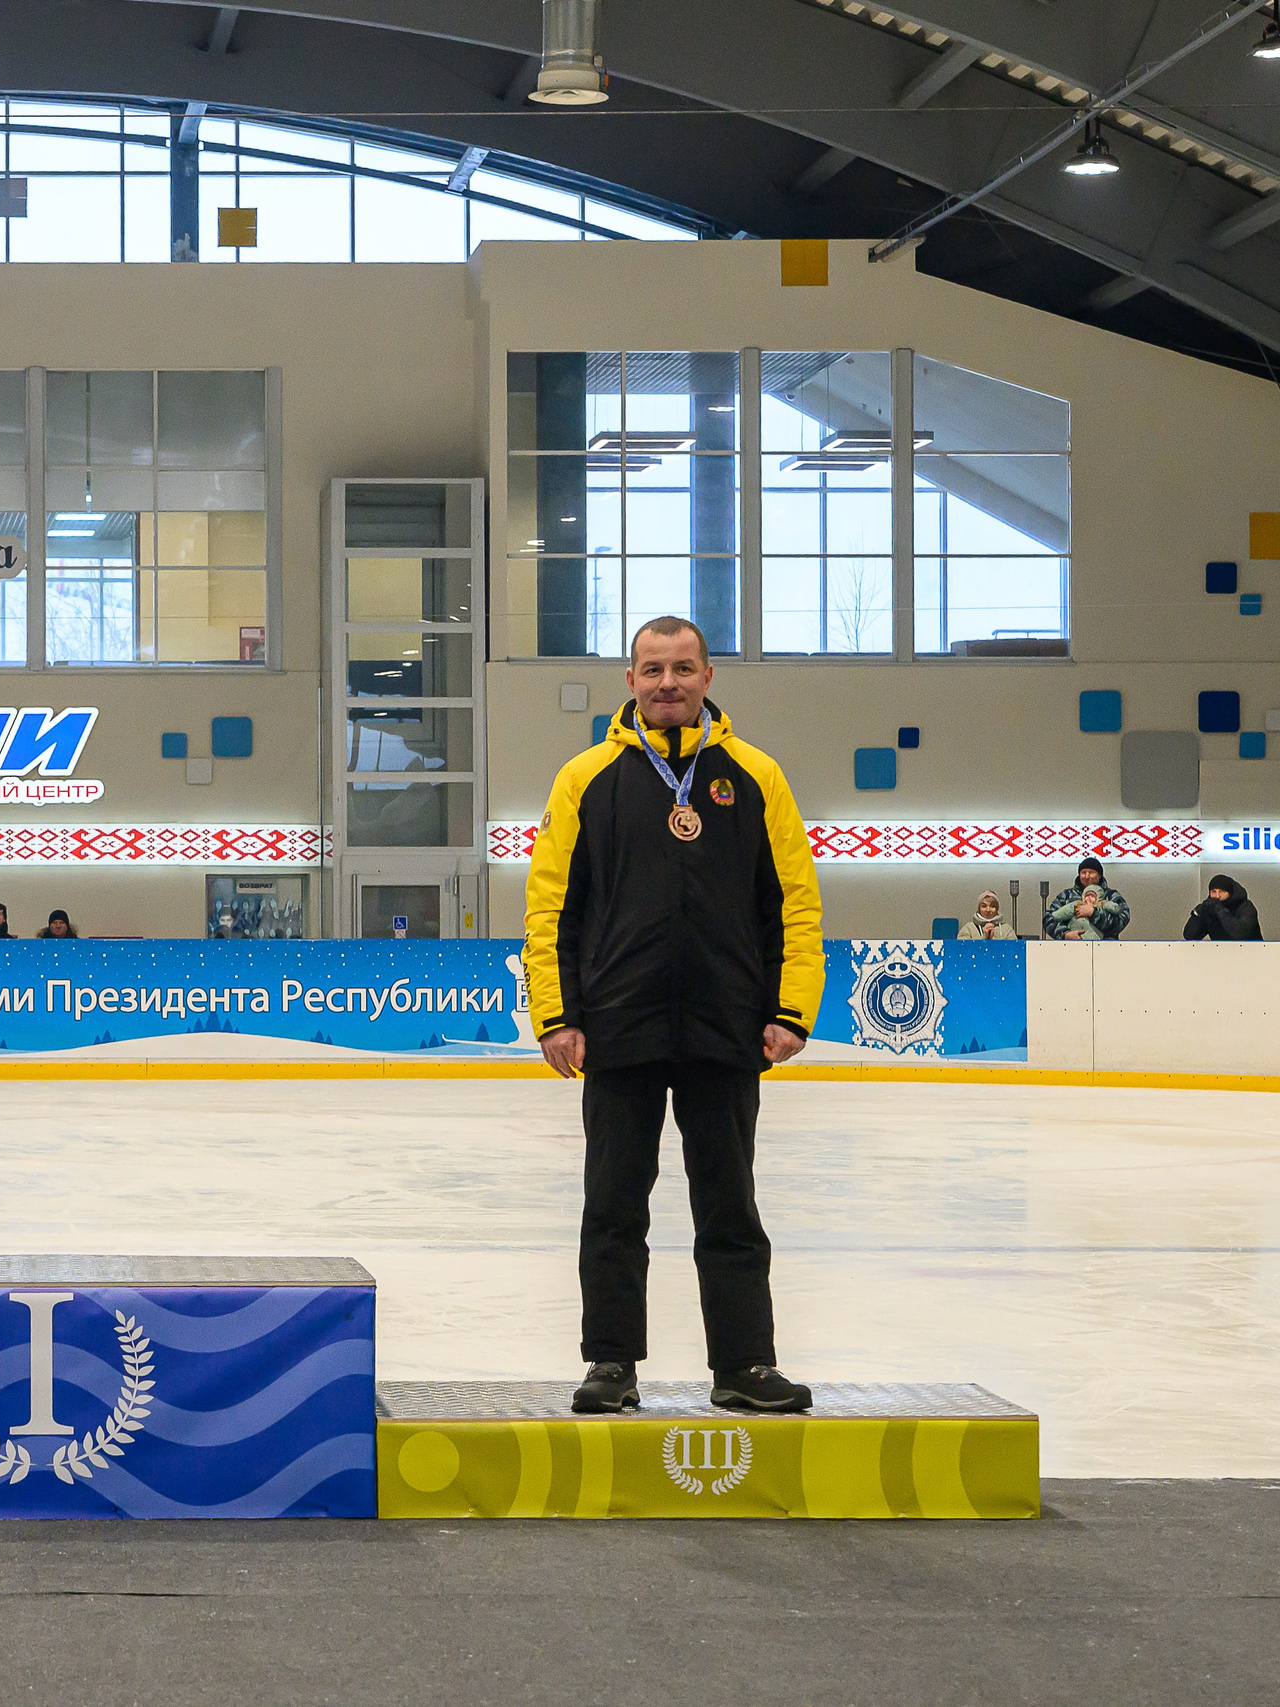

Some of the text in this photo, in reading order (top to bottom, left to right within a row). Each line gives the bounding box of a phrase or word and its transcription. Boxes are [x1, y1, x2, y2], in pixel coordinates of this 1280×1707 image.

[26, 785, 99, 800] ЦЕНТР
[46, 979, 271, 1021] Президента
[281, 978, 504, 1022] Республики
[8, 1292, 75, 1435] I
[677, 1429, 738, 1469] III
